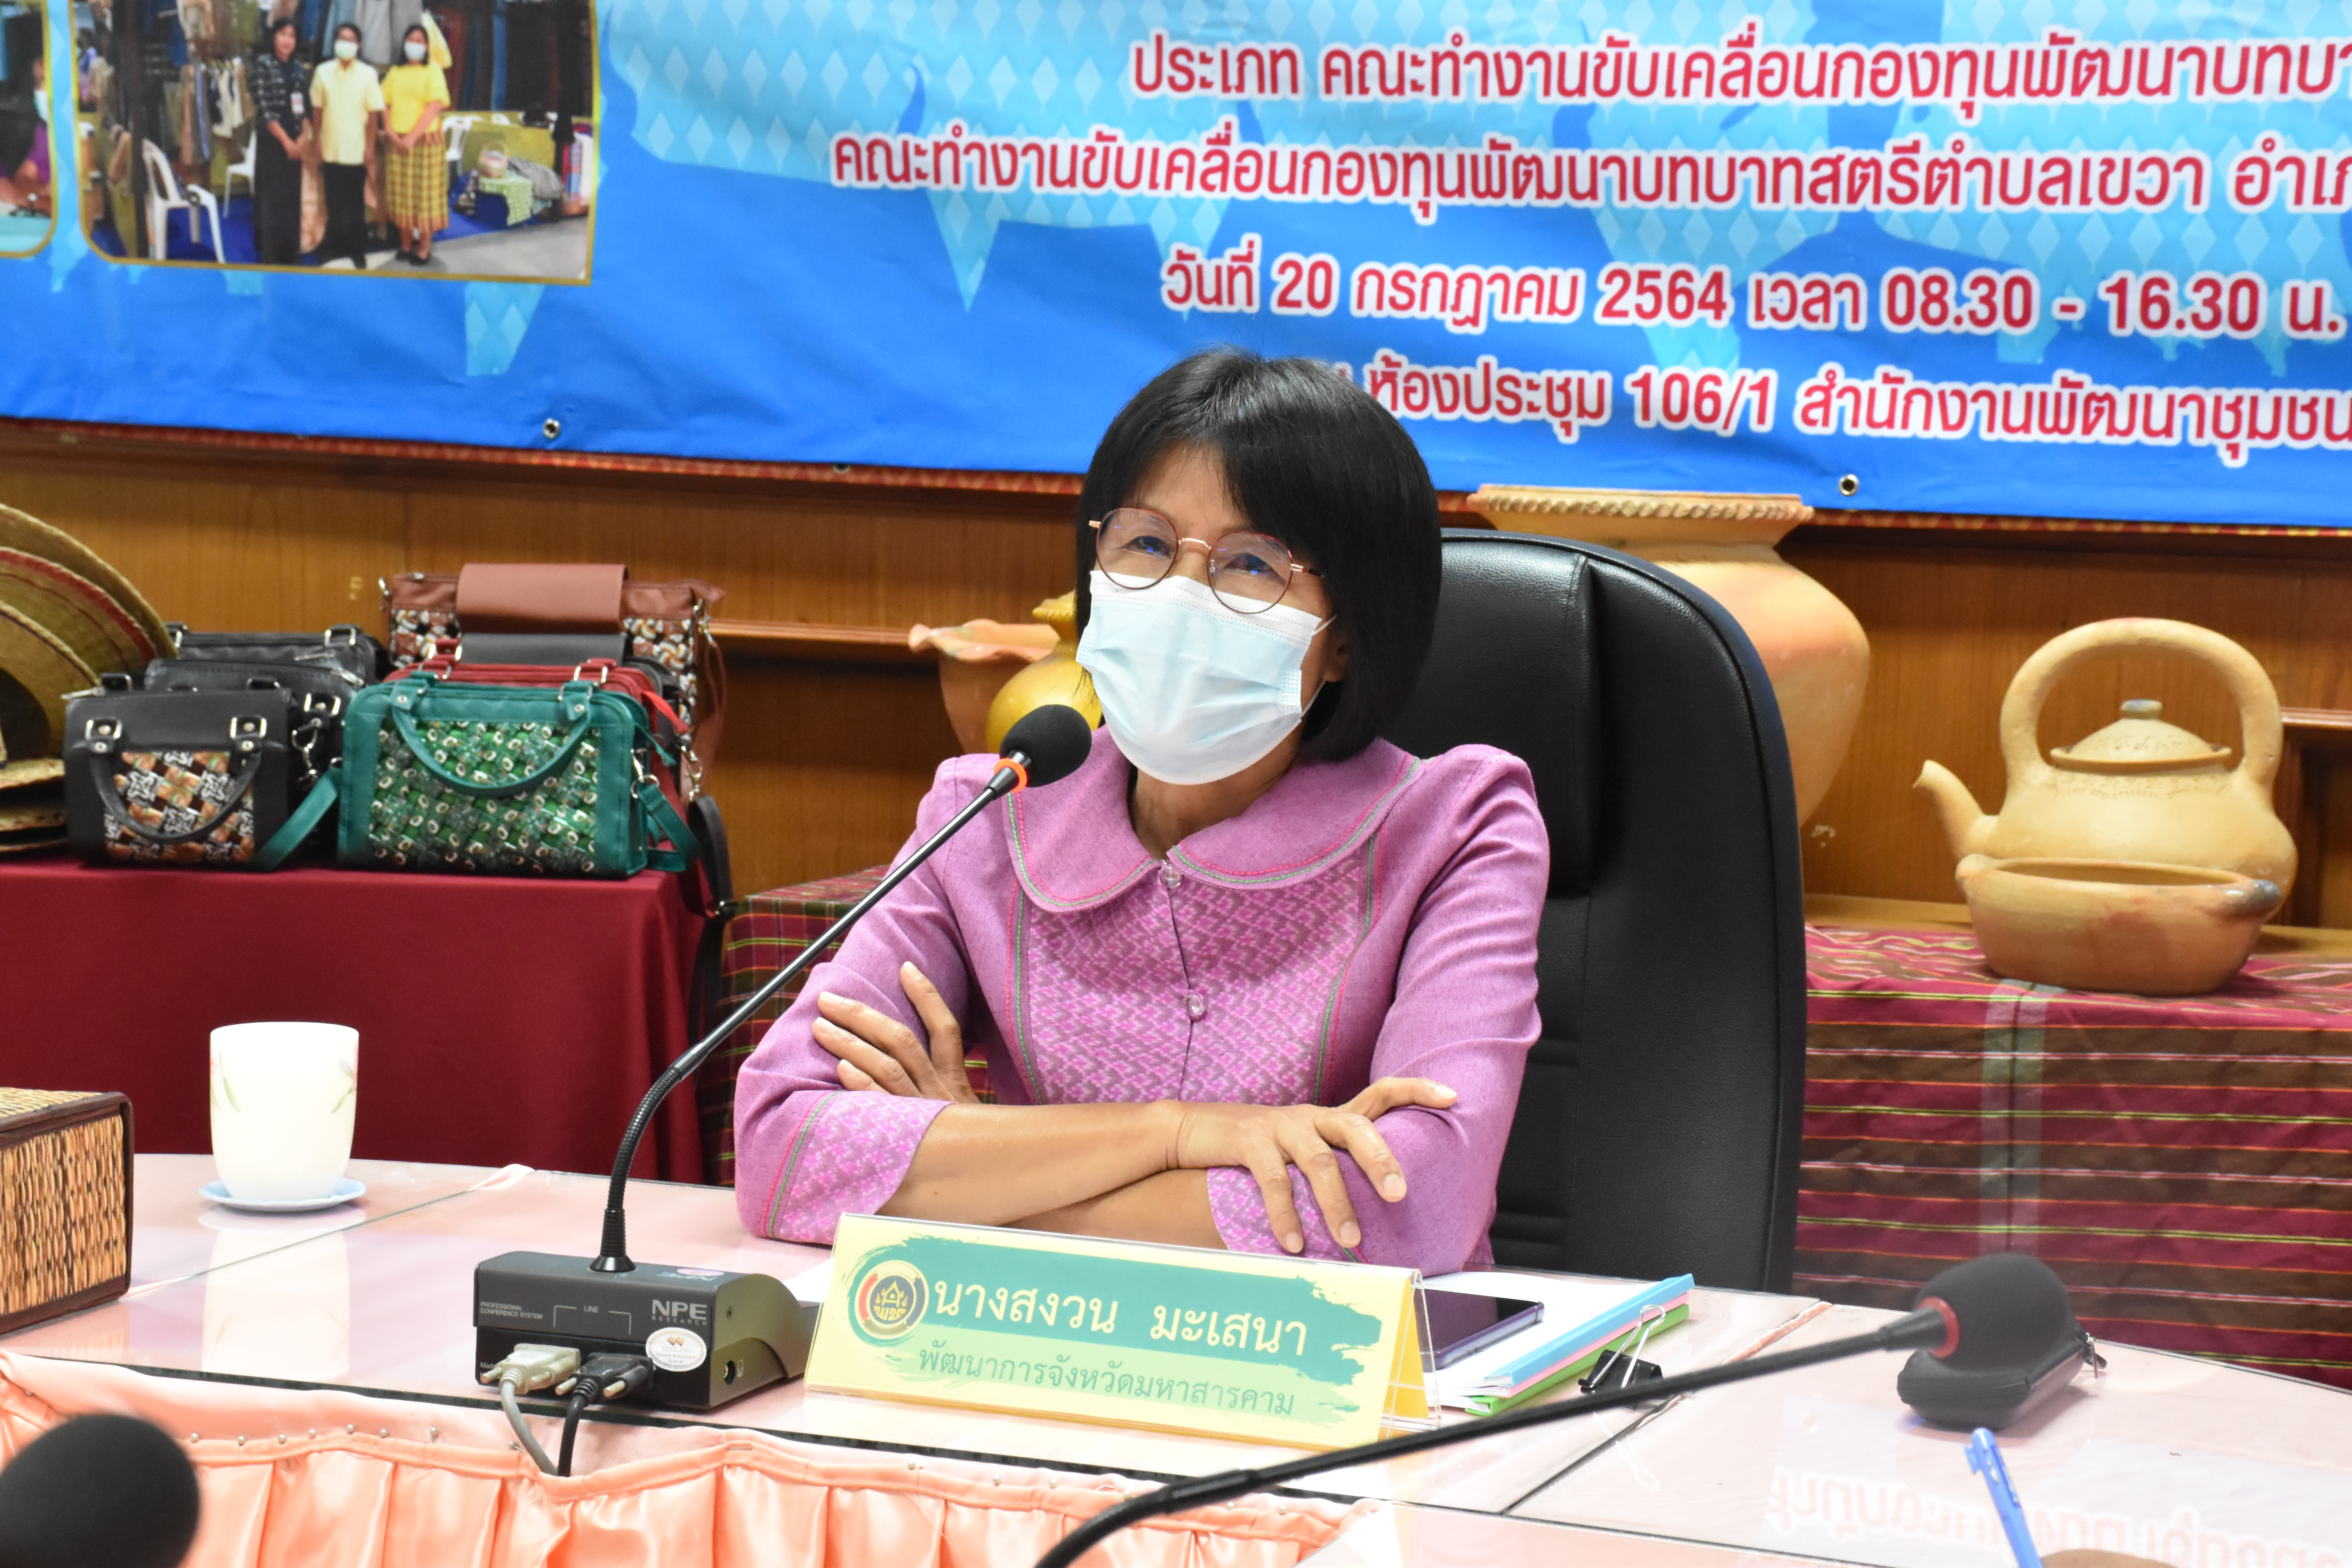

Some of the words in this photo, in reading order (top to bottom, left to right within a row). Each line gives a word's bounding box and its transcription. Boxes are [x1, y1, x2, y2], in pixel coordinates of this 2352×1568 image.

[1136, 35, 1298, 93] ประเภท
[1168, 240, 1254, 306] วันที่
[1278, 260, 1333, 309] 20
[1357, 269, 1578, 327] กรกฎาคม
[1602, 269, 1727, 320] 2564
[1755, 279, 1860, 323] เวลา
[1887, 274, 2032, 328] 08.30
[2106, 278, 2259, 331] 16.30
[2290, 287, 2339, 332] น.
[1370, 356, 1604, 437] ห้องประชุม
[1632, 372, 1769, 430] 106/1
[481, 1301, 523, 1311] PROFESSIONAL
[481, 1308, 519, 1317] CONFERENCE
[651, 1314, 707, 1326] RESEARCH
[652, 1299, 707, 1320] NPE
[935, 1281, 1118, 1334] นางสงวน
[1150, 1305, 1307, 1356] มะเสนา
[920, 1340, 1294, 1415] พัฒนาการจังหวัดมหาสารคาม
